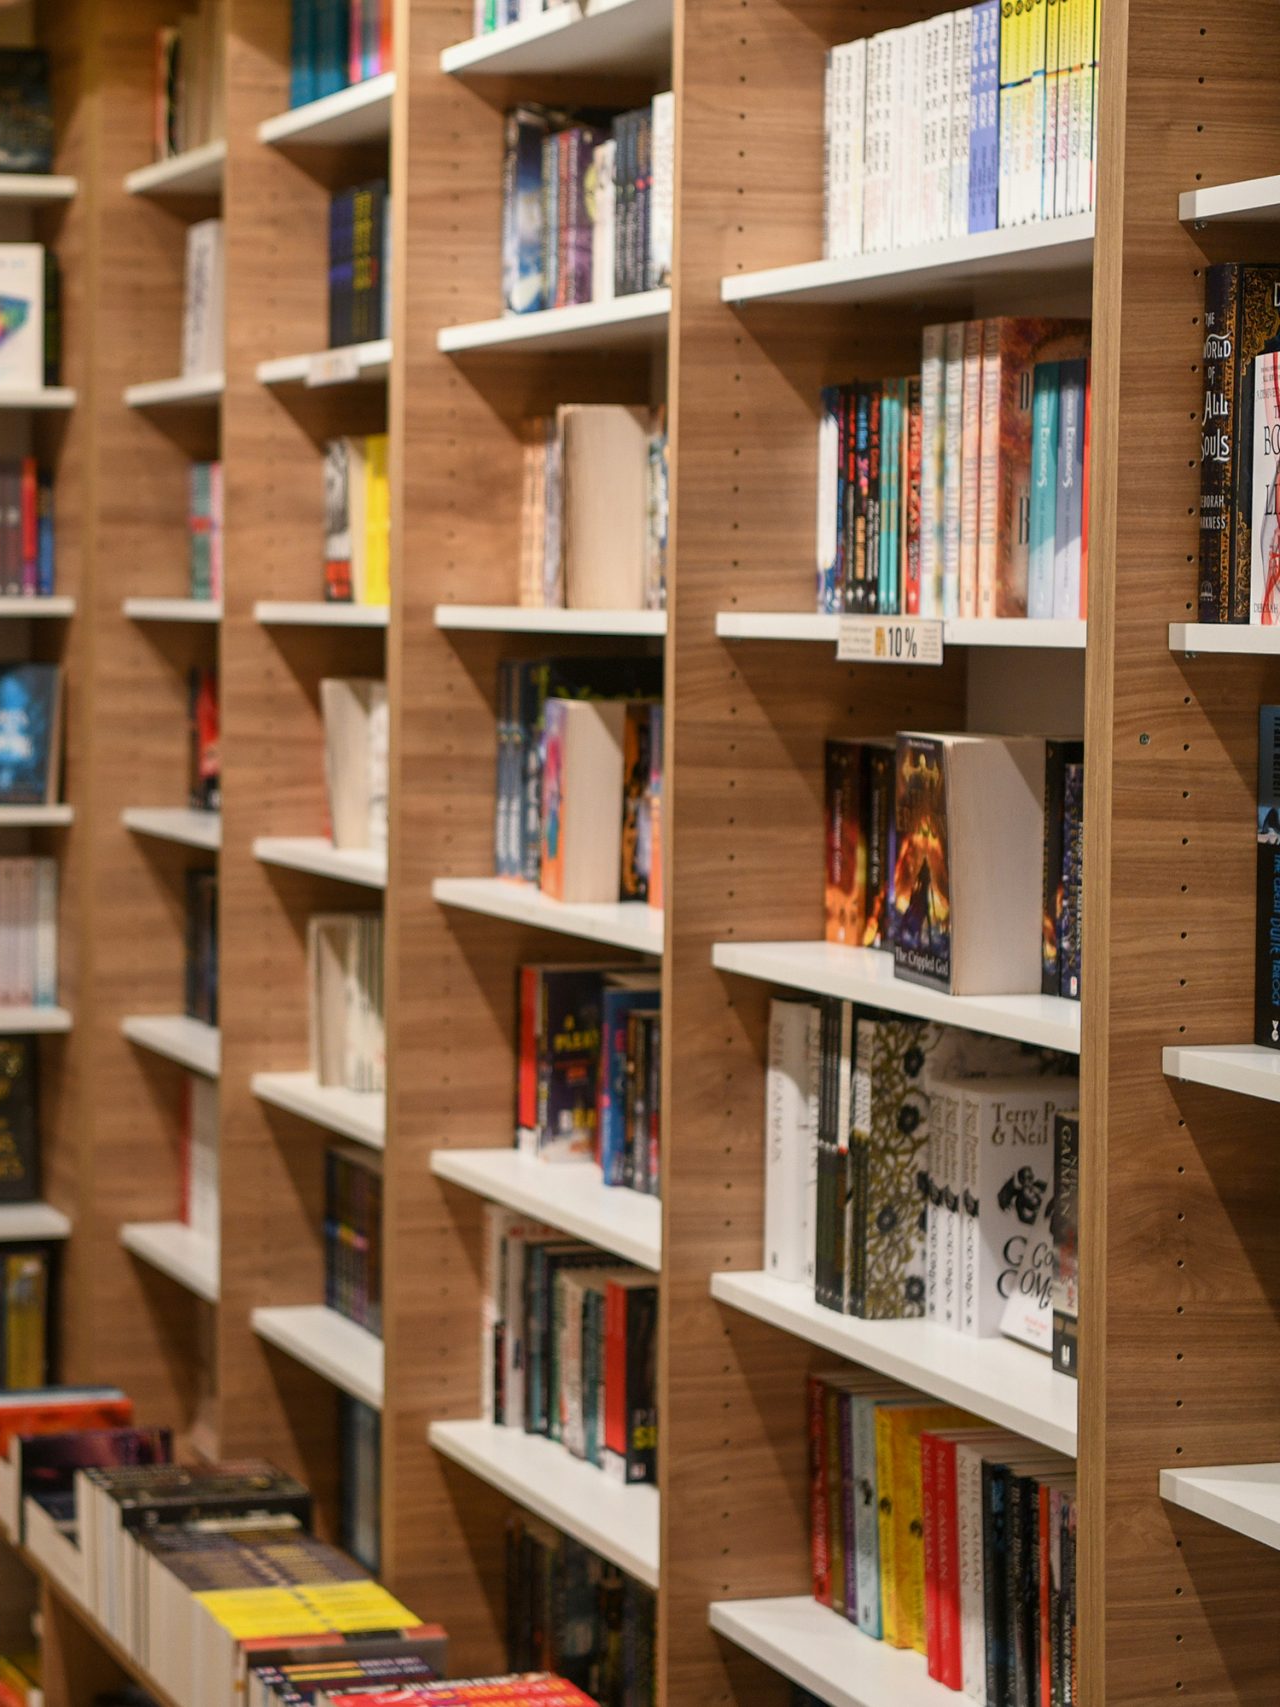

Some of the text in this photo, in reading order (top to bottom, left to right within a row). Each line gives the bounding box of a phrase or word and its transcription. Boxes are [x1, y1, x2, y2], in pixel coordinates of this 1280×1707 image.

[1205, 312, 1215, 326] THE
[1202, 391, 1228, 426] ALL
[992, 1102, 1039, 1125] Terry
[992, 1125, 1048, 1146] & Neil
[1060, 1125, 1072, 1217] GAIMAN
